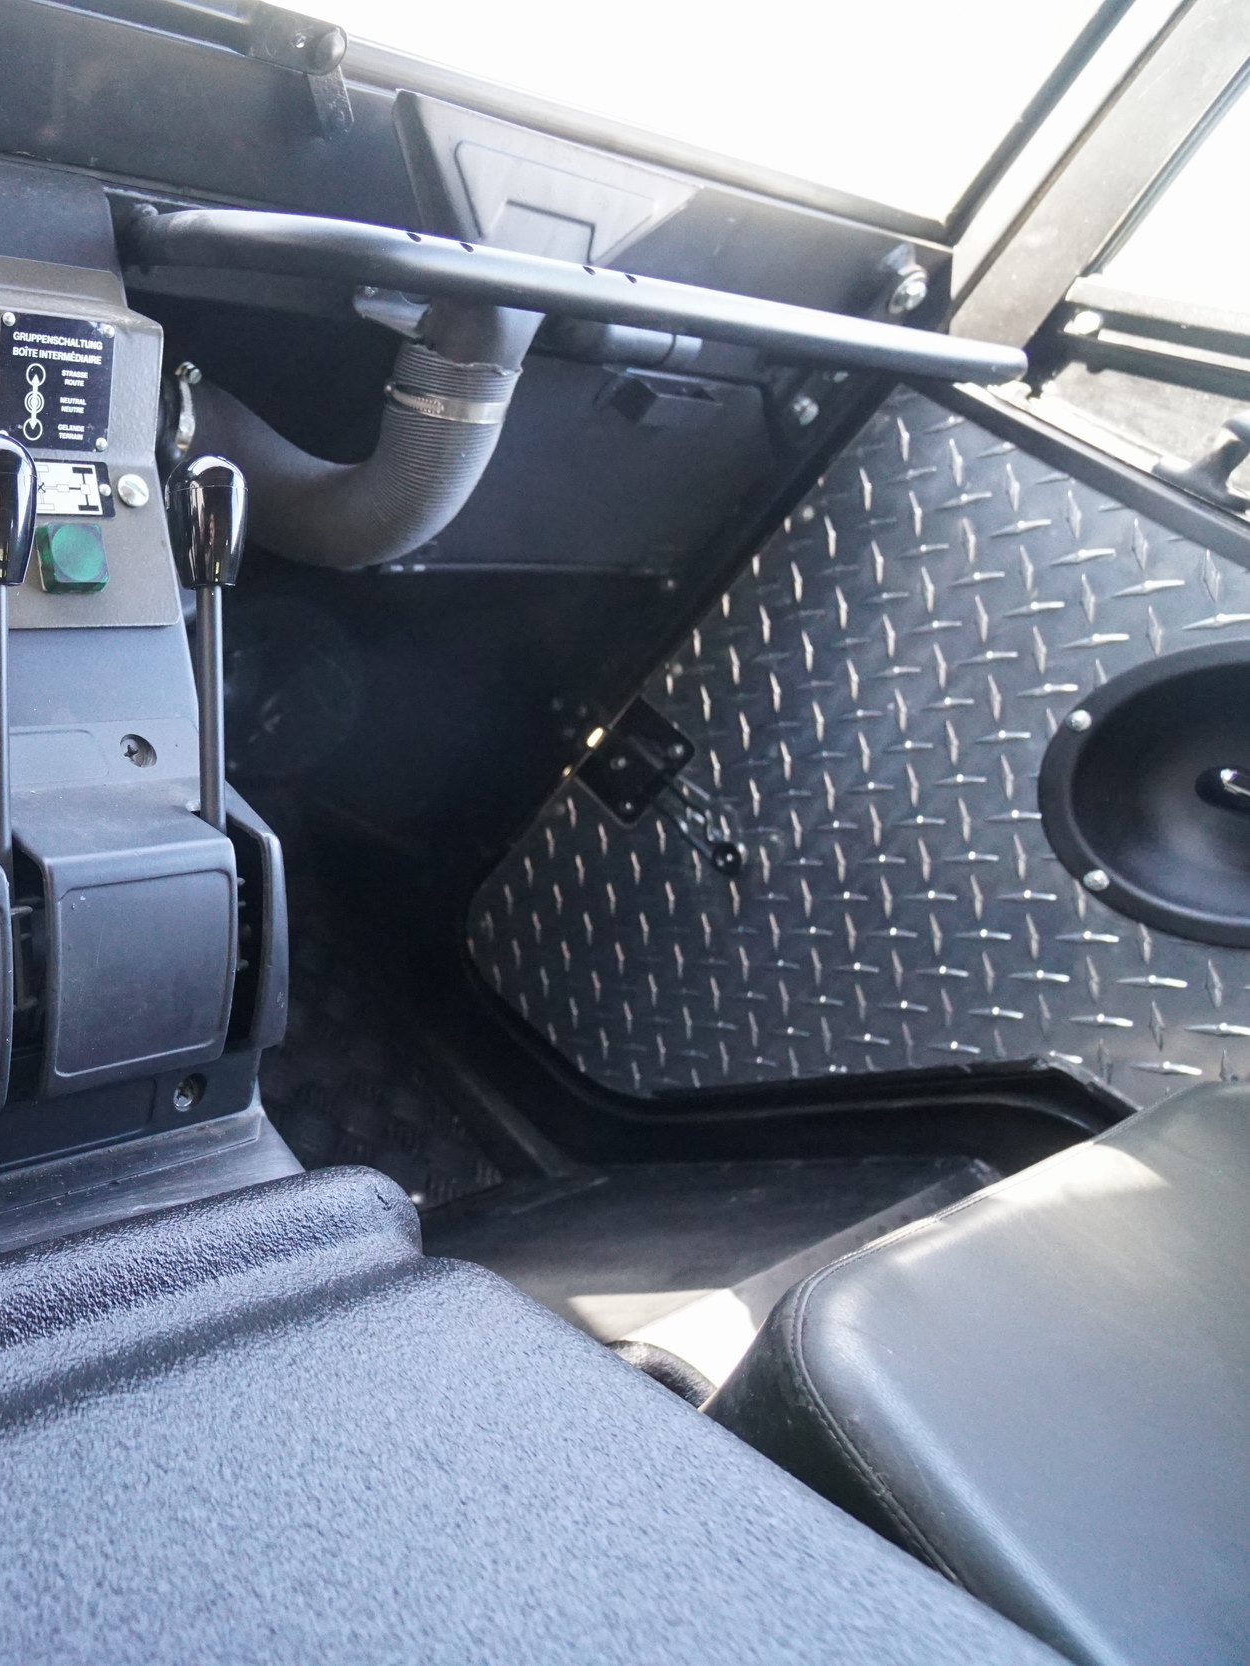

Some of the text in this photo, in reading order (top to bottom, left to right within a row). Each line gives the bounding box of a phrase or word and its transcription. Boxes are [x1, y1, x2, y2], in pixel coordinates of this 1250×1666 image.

[13, 332, 102, 350] GRUPPENSCHALTUNG
[13, 346, 102, 364] BOÎTE INTERMÉDIAIRE
[62, 370, 88, 378] STRASSE
[64, 379, 84, 387] ROUTE
[60, 397, 86, 405] NEUTRAL
